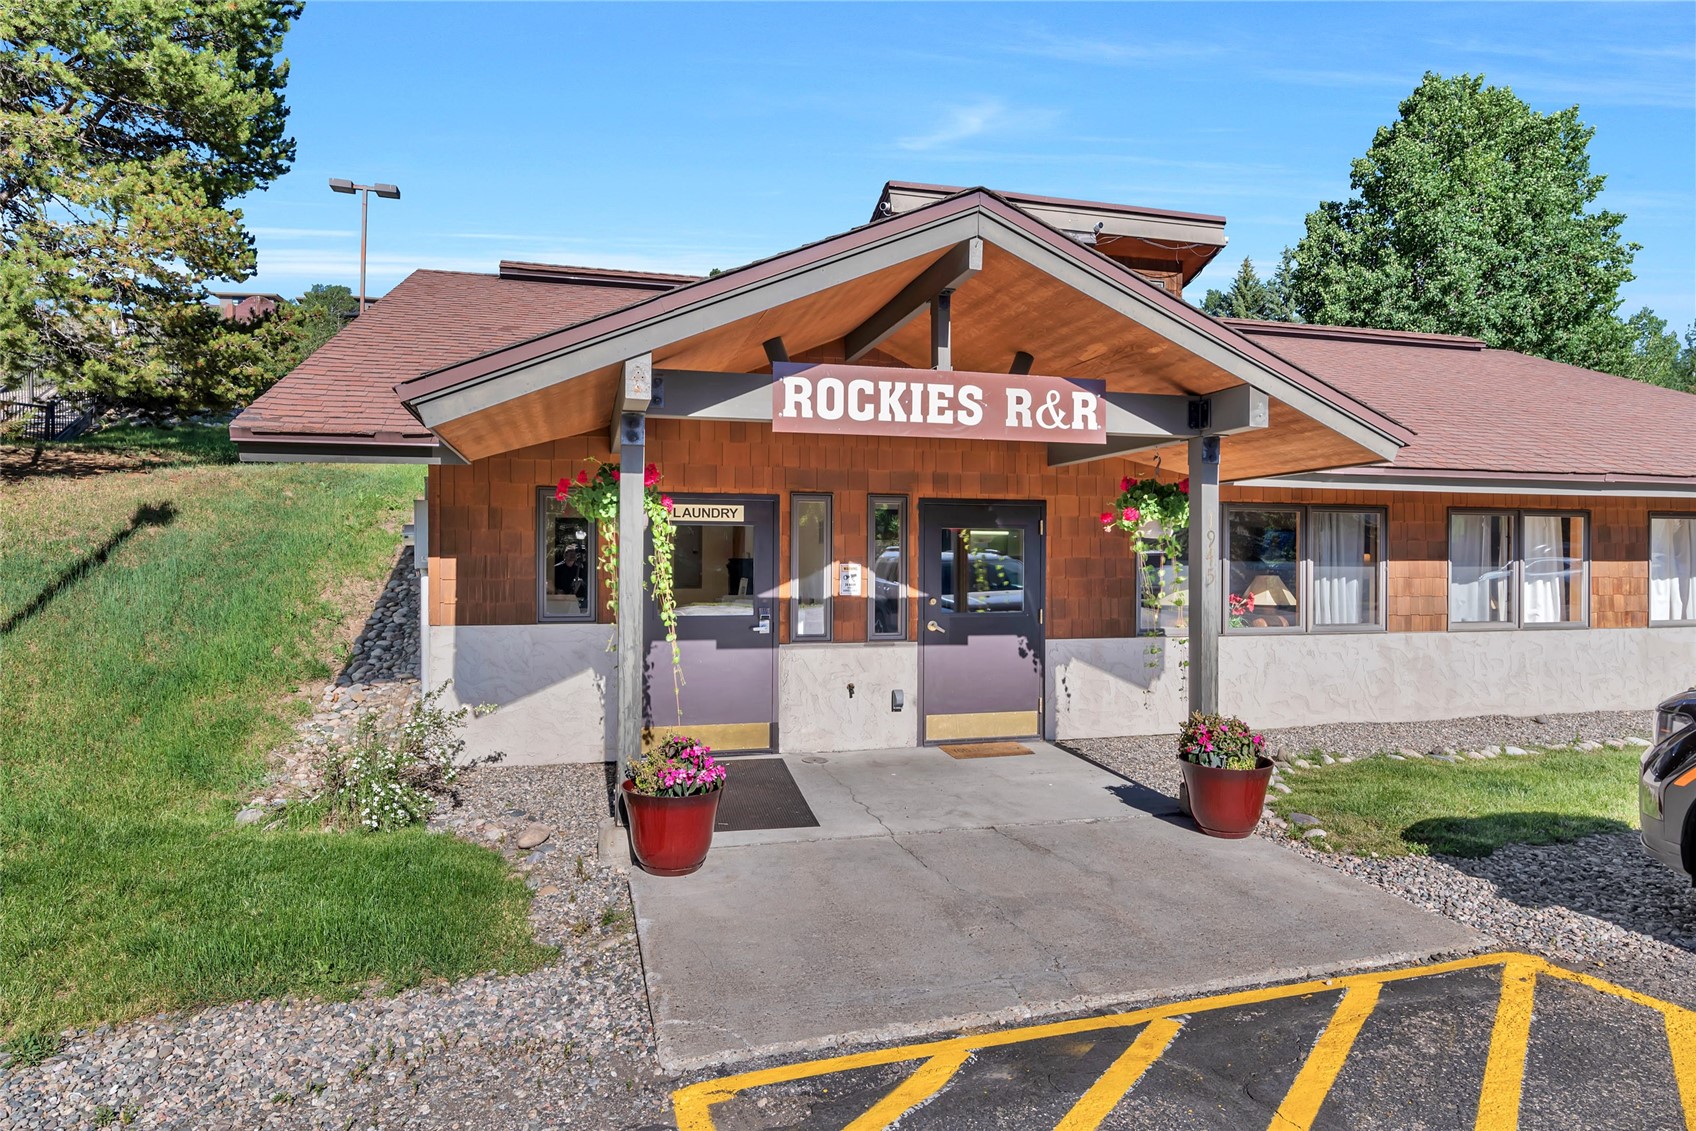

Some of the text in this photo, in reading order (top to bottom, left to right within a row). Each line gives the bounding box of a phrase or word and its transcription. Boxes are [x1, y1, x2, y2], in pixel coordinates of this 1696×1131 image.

[782, 376, 1099, 430] ROCKIES R&R
[673, 507, 738, 518] LAUNDRY
